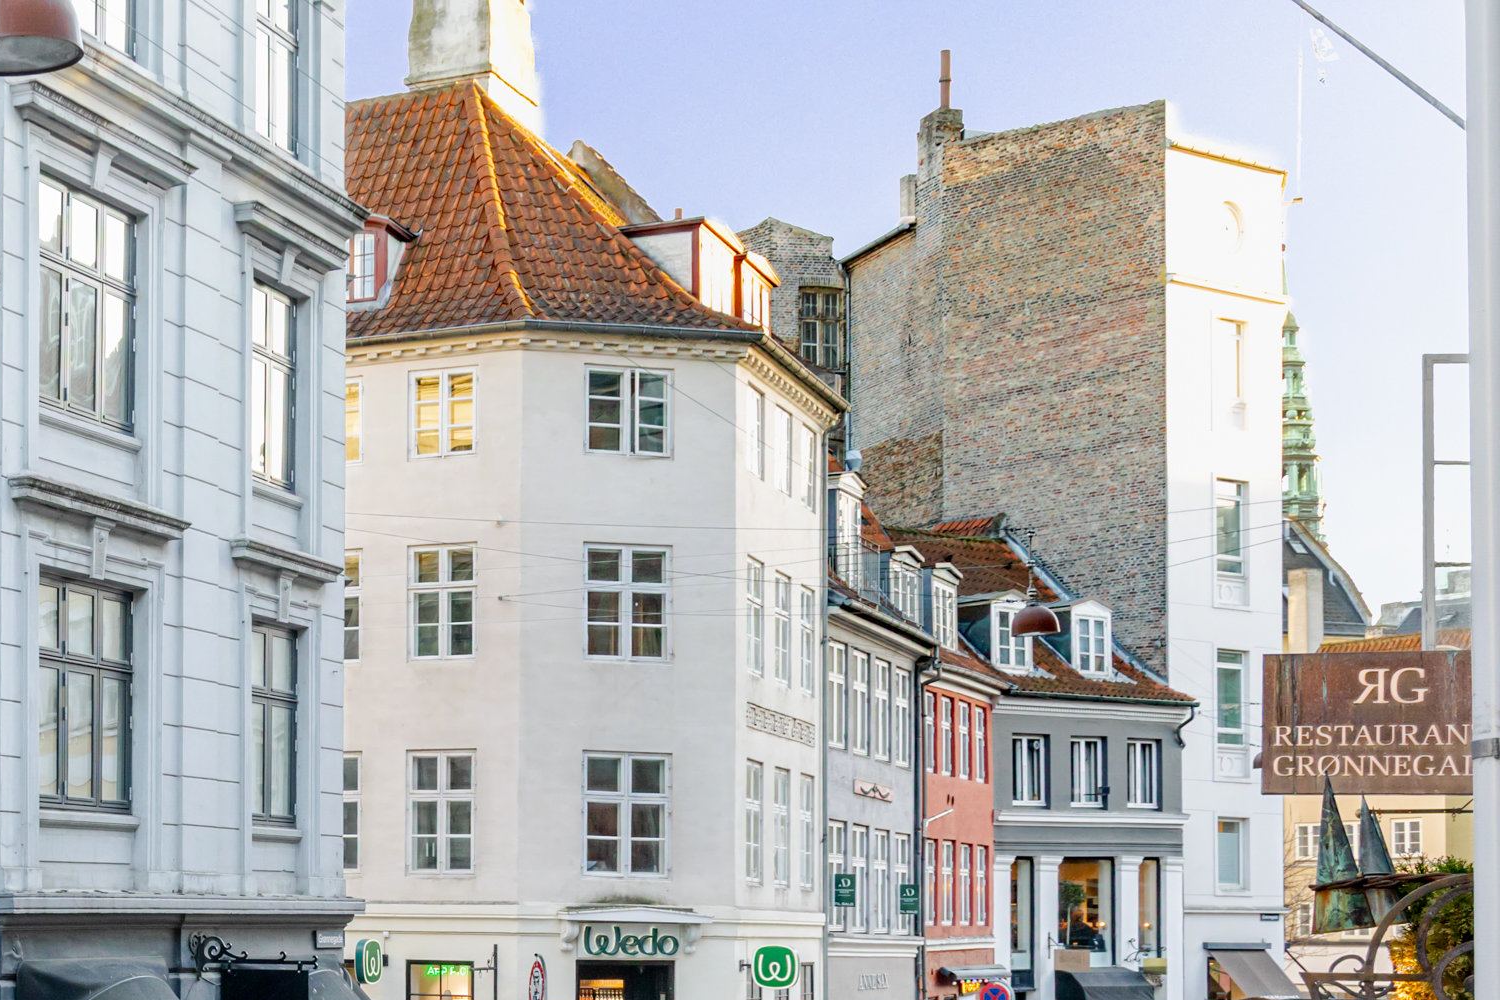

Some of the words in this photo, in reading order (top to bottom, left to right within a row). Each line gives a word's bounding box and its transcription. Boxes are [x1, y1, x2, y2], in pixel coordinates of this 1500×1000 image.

[1272, 723, 1474, 747] RESTAURAN
[1272, 753, 1475, 777] GRØNNEGA
[583, 925, 680, 956] Wedo
